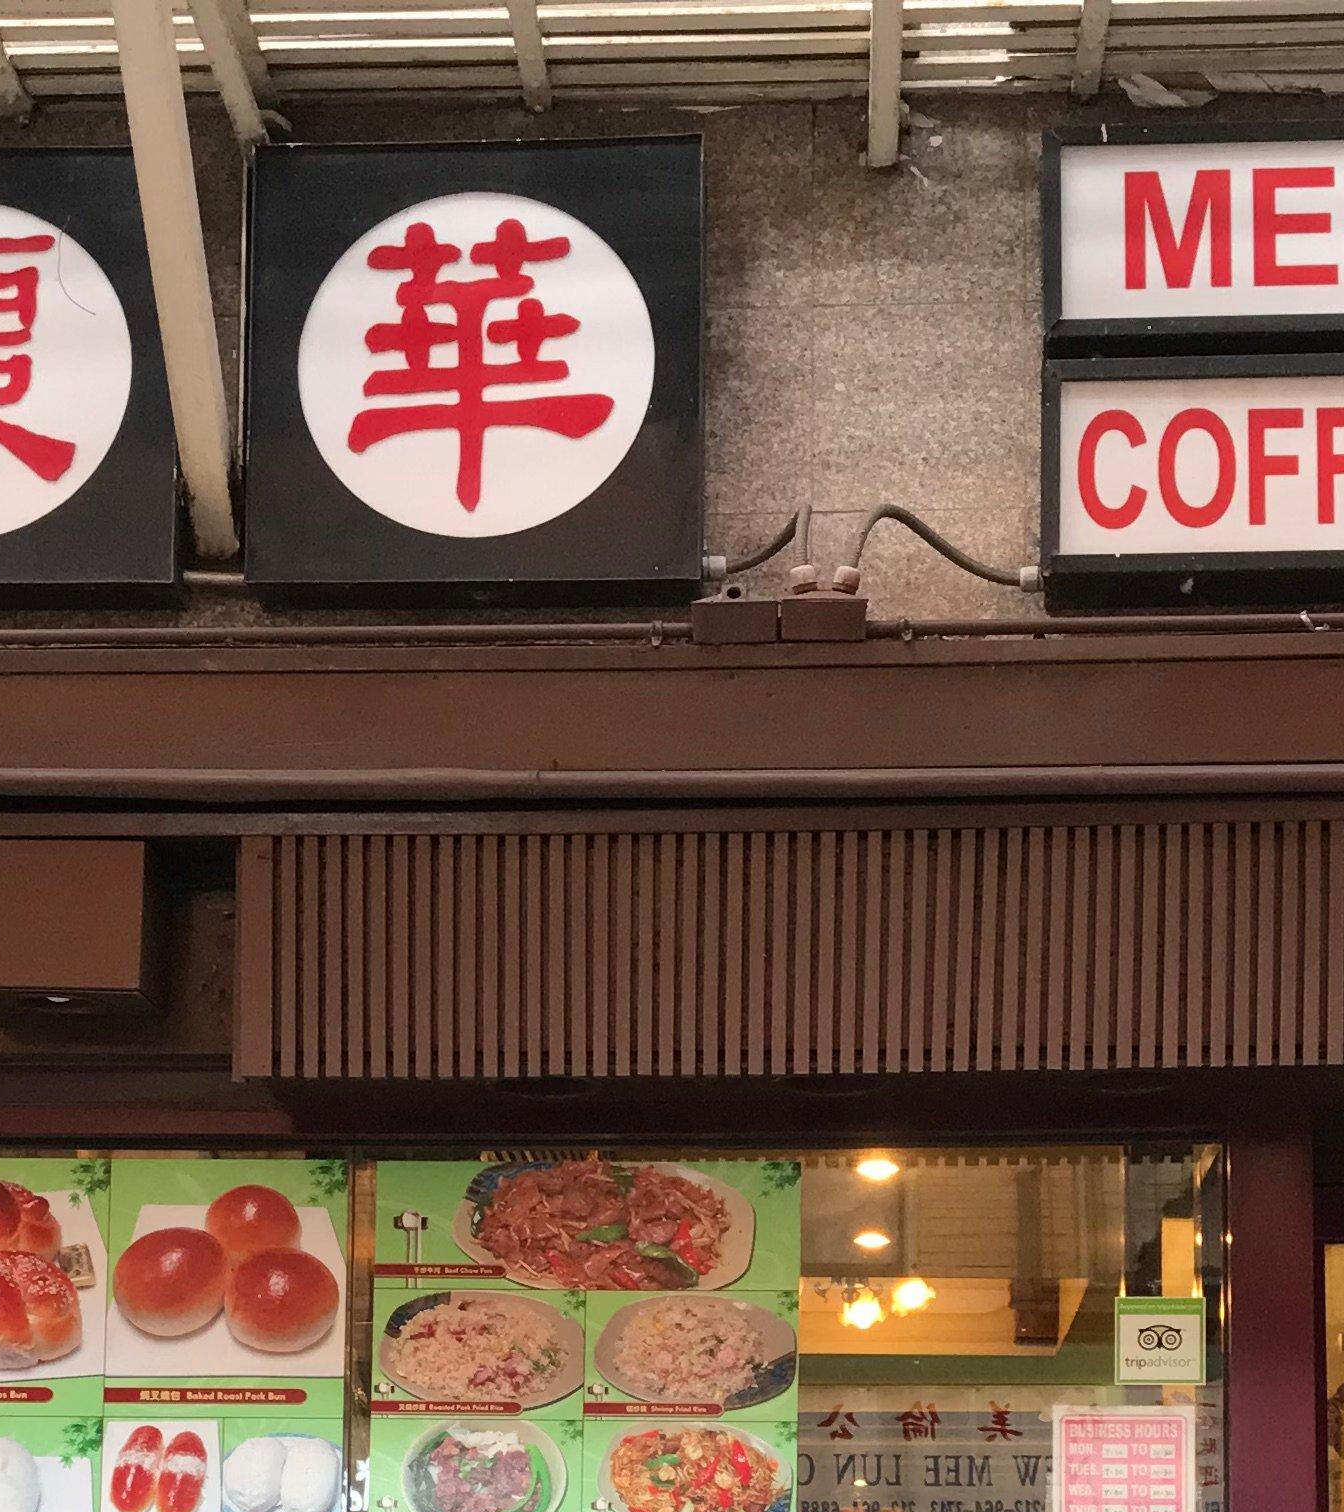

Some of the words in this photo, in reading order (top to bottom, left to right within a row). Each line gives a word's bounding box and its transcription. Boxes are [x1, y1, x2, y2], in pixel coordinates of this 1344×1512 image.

[1125, 1355, 1191, 1370] tripadvisor
[217, 1392, 242, 1400] Roast
[245, 1392, 265, 1400] Pork
[268, 1392, 285, 1400] Bun
[1069, 1424, 1131, 1438] BUSINESS
[1134, 1424, 1178, 1438] HOURS
[1130, 1443, 1147, 1455] TO
[1130, 1464, 1147, 1476] TO
[1130, 1484, 1147, 1497] TO
